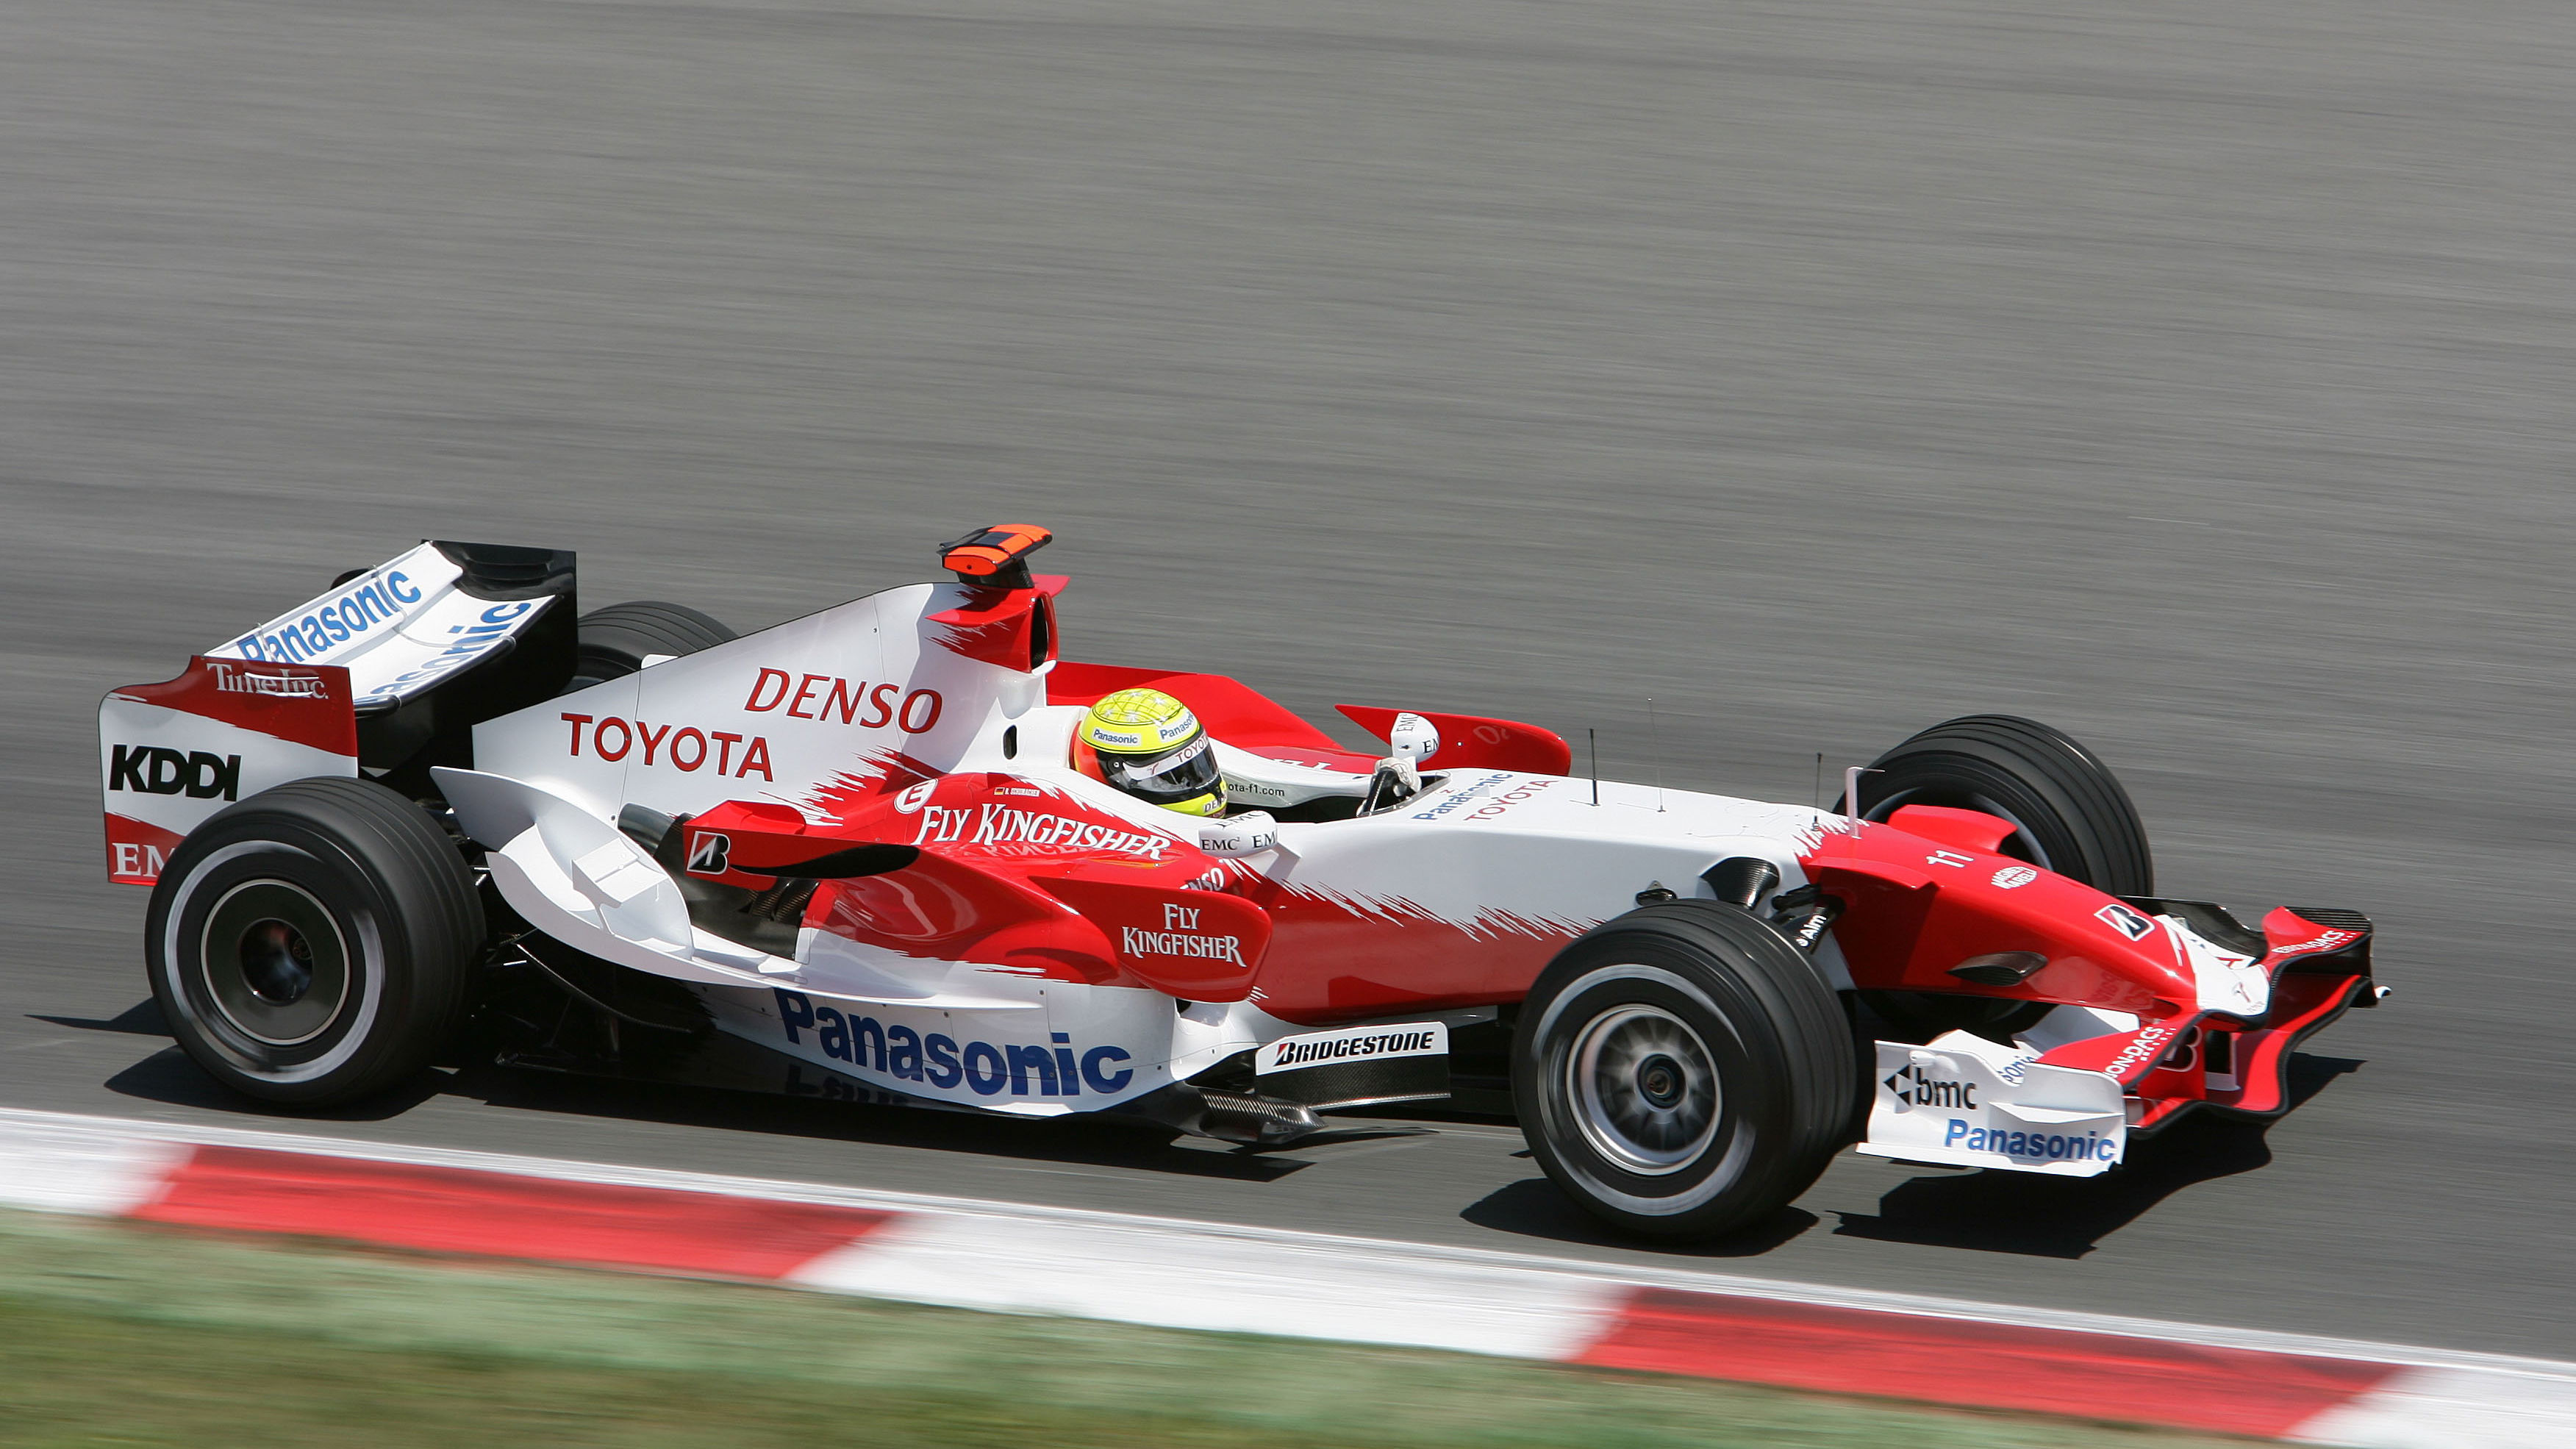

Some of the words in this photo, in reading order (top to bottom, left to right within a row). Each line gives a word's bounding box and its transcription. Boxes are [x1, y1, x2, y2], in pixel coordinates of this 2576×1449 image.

[237, 570, 422, 663] Panasonic
[744, 666, 943, 734] DENSO
[560, 712, 775, 782] TOYOTA
[1093, 729, 1139, 745] Panasonic
[109, 743, 241, 802] KDDI
[1463, 779, 1559, 822] TOYOTA
[910, 805, 973, 846] FLY
[969, 803, 1172, 862] KINGFISHER
[1925, 849, 1975, 868] 11
[1162, 902, 1201, 931] FLY
[1121, 926, 1248, 968] KINGFISHER
[773, 987, 1134, 1096] Panasonic
[1273, 1031, 1436, 1067] BRIDGESTONE
[1916, 1067, 1977, 1110] bmc
[1944, 1118, 2117, 1162] Panasonic
